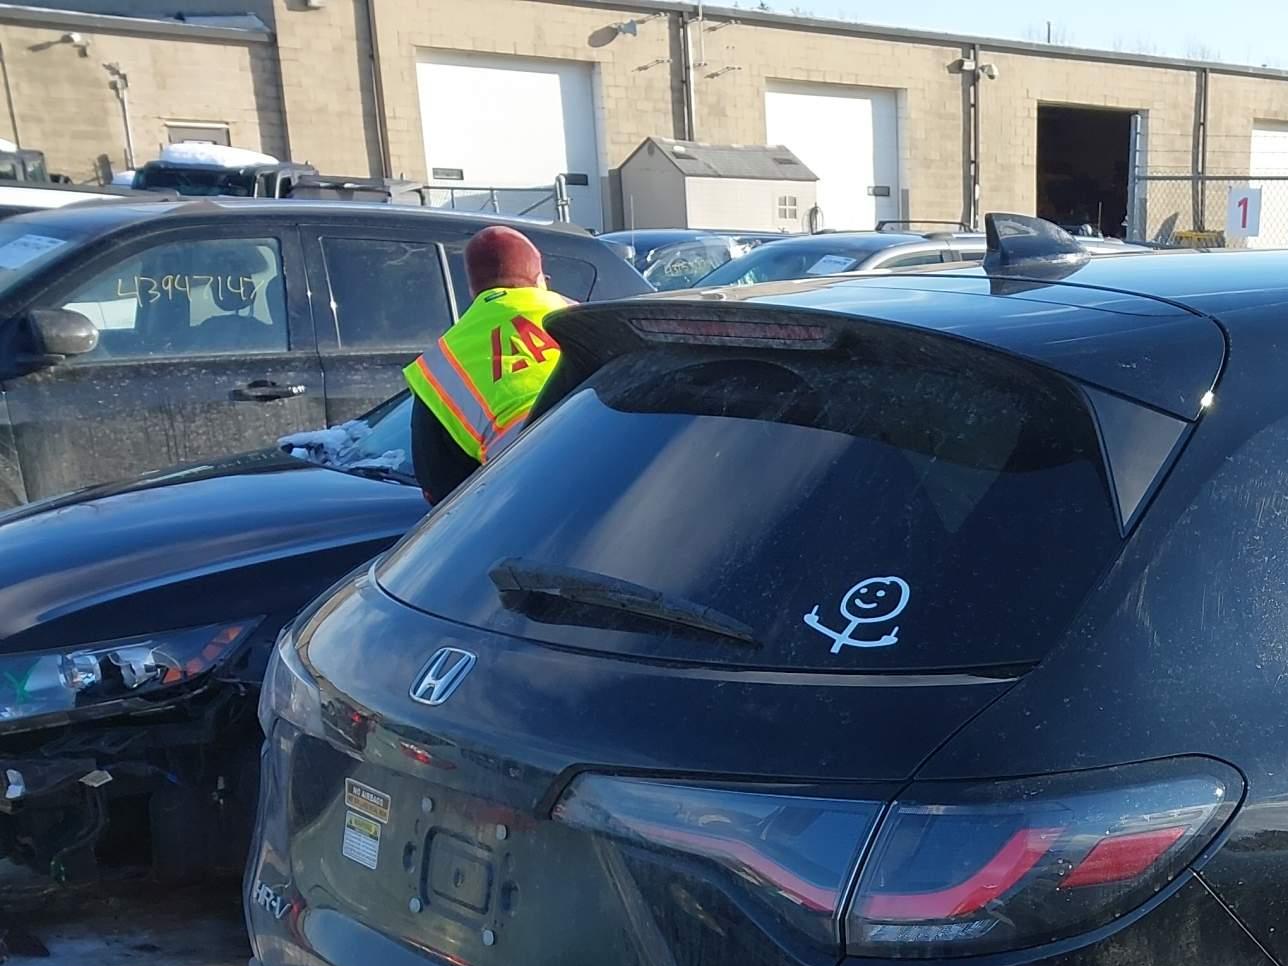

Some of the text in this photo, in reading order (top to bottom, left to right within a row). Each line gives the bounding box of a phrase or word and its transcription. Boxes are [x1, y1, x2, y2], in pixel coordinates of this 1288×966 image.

[1238, 197, 1248, 228] 1
[117, 274, 265, 307] 43947147
[253, 880, 292, 919] HR-V
